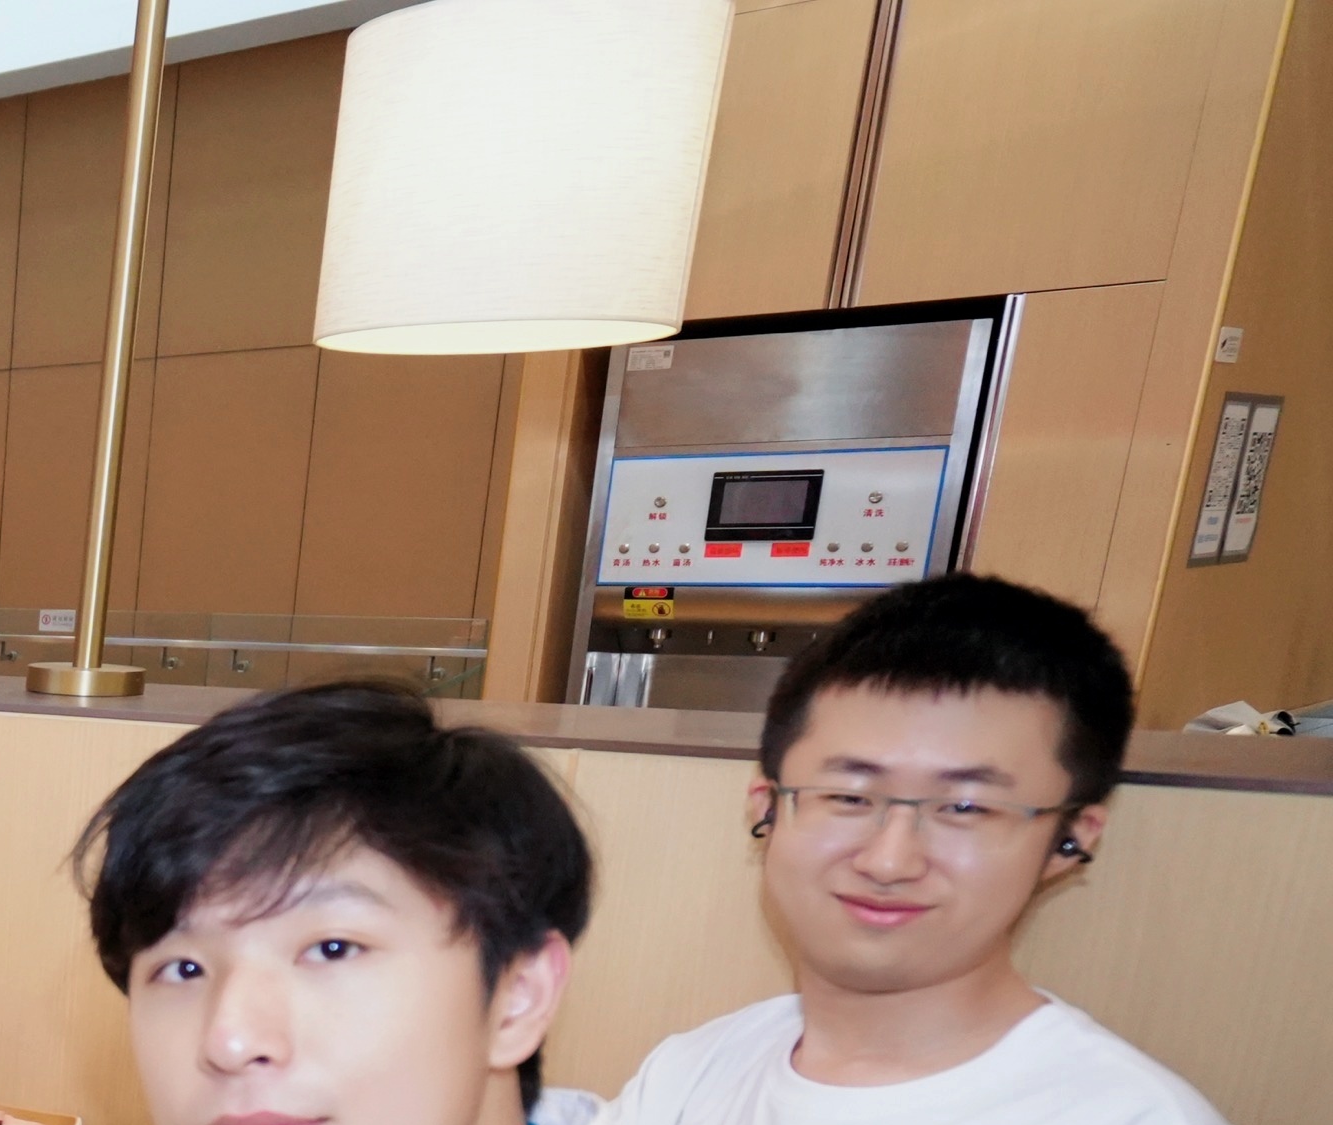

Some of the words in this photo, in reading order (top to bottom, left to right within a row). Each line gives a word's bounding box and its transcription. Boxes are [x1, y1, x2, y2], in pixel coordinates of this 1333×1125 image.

[863, 508, 885, 517] 清洗
[642, 558, 661, 567] 热水
[854, 558, 876, 567] 冰水
